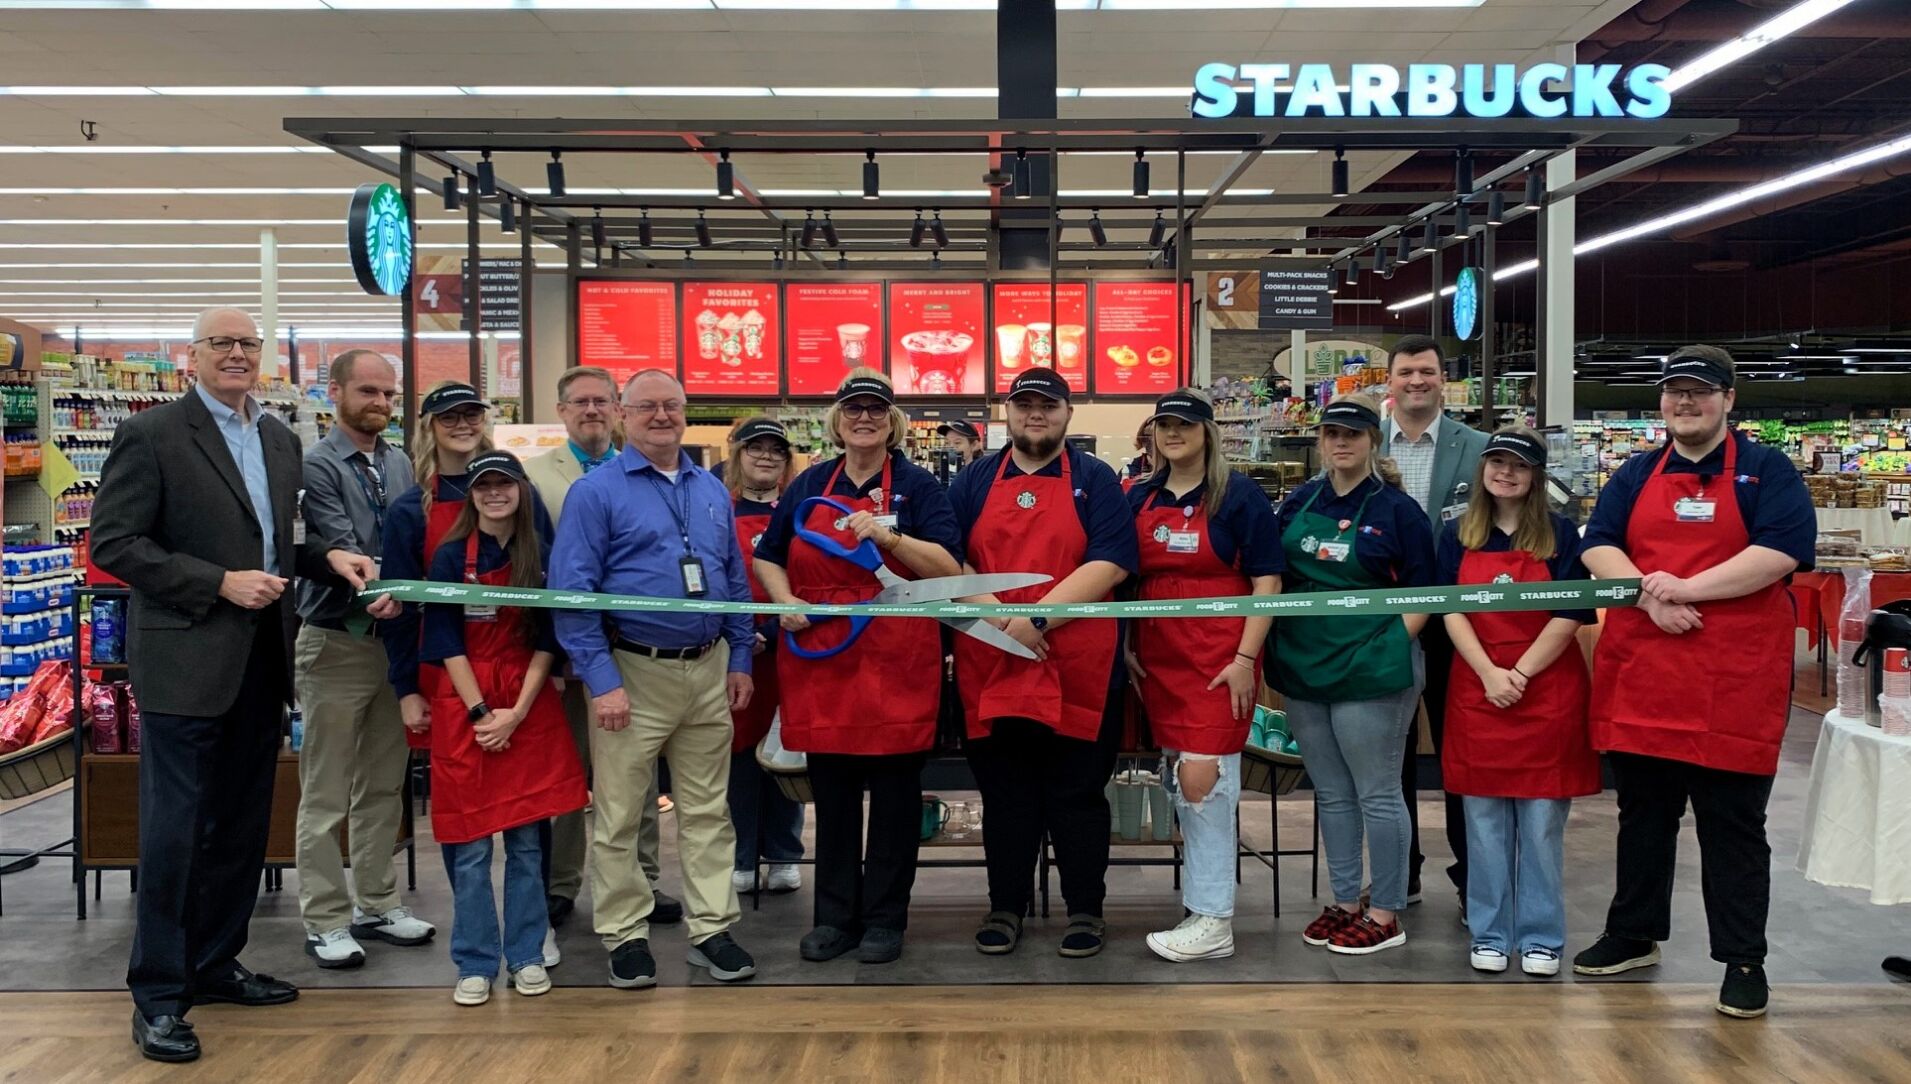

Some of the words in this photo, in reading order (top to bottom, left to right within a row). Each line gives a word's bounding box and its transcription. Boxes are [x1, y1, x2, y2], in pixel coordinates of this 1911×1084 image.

[1193, 63, 1673, 119] STARBUCKS
[420, 279, 440, 309] 4
[703, 298, 759, 307] FAVORITES
[708, 289, 753, 297] HOLIDAY
[1218, 277, 1235, 306] 2
[482, 591, 541, 600] STARBUCKS
[1254, 601, 1313, 609] STARBUCKS
[1385, 596, 1446, 605] STARBUCKS
[1520, 591, 1581, 600] STARBUCKS
